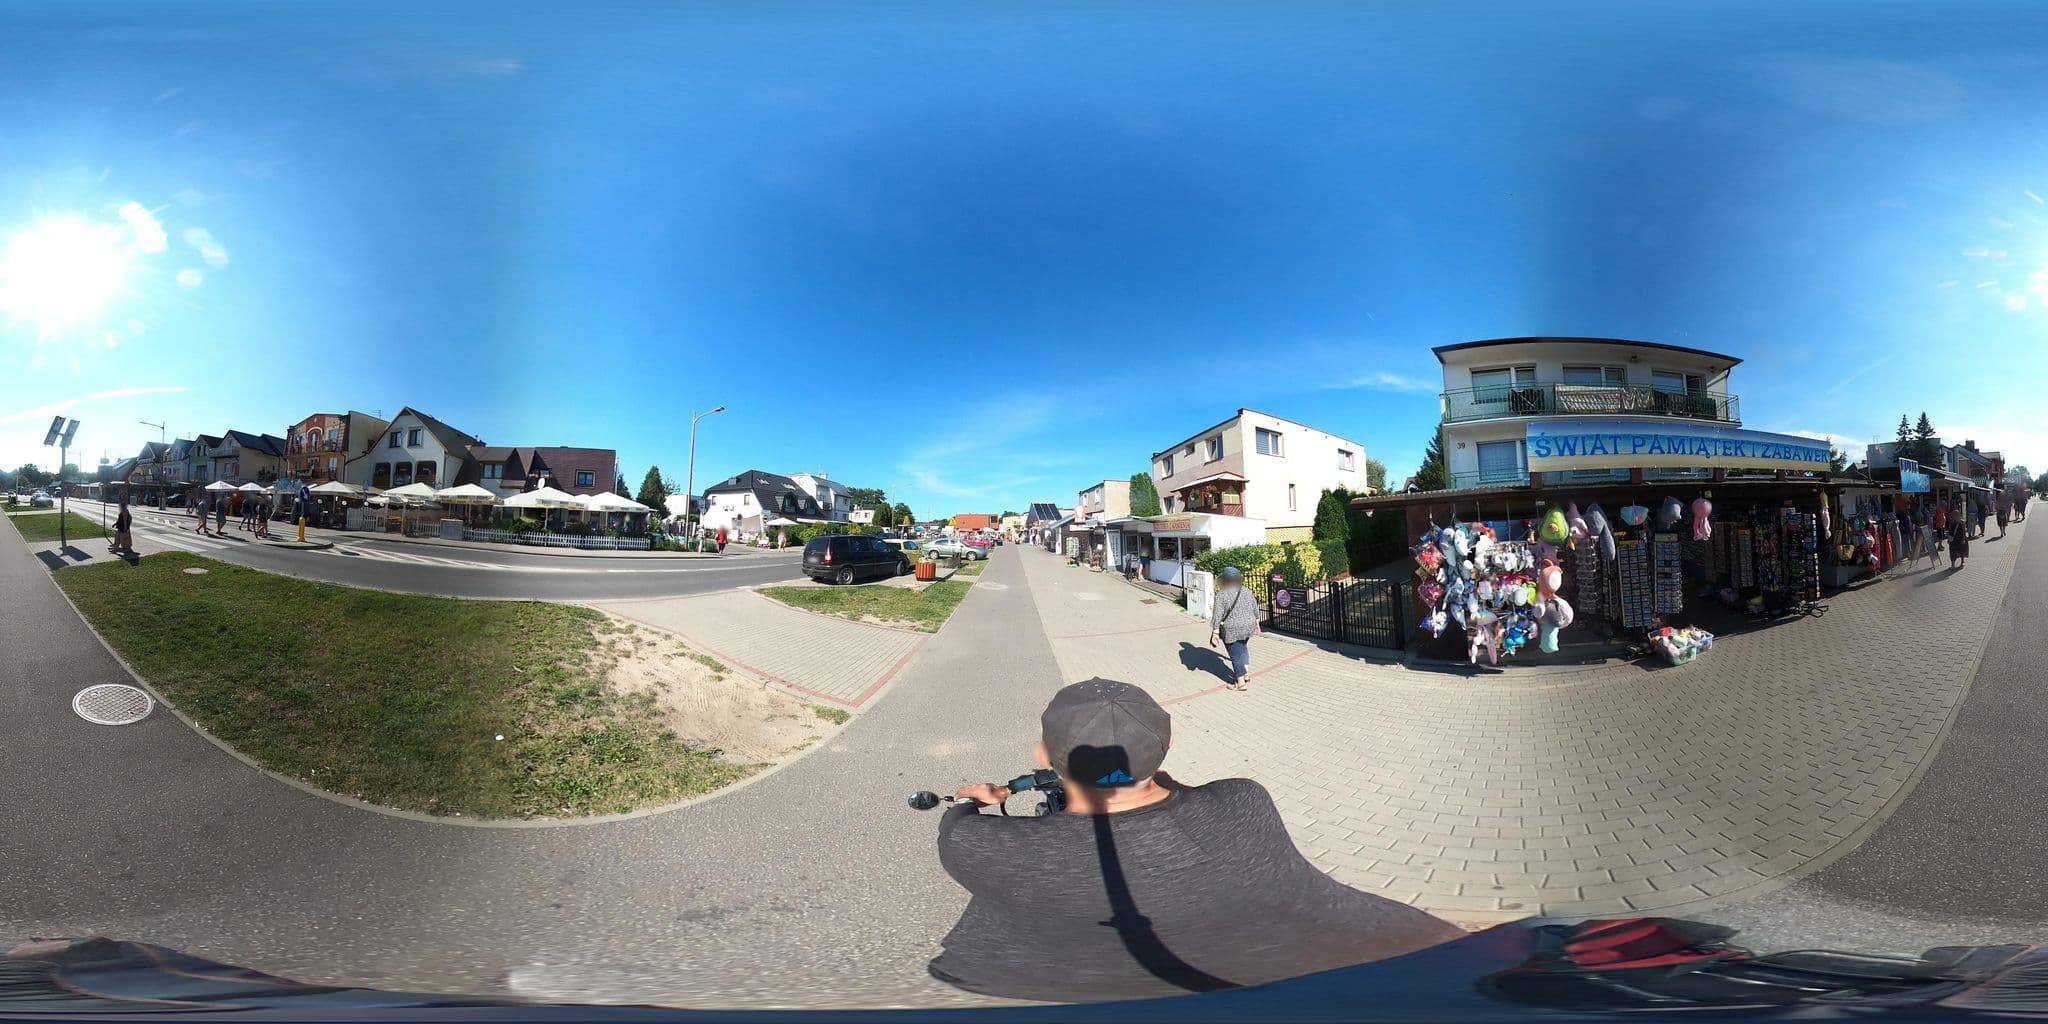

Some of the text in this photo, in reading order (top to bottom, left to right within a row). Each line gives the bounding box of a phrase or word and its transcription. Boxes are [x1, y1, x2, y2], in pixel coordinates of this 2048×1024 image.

[1456, 442, 1466, 450] 39
[1534, 432, 1828, 463] ŚWIAT PAMIĄTEK I ZABAWEK
